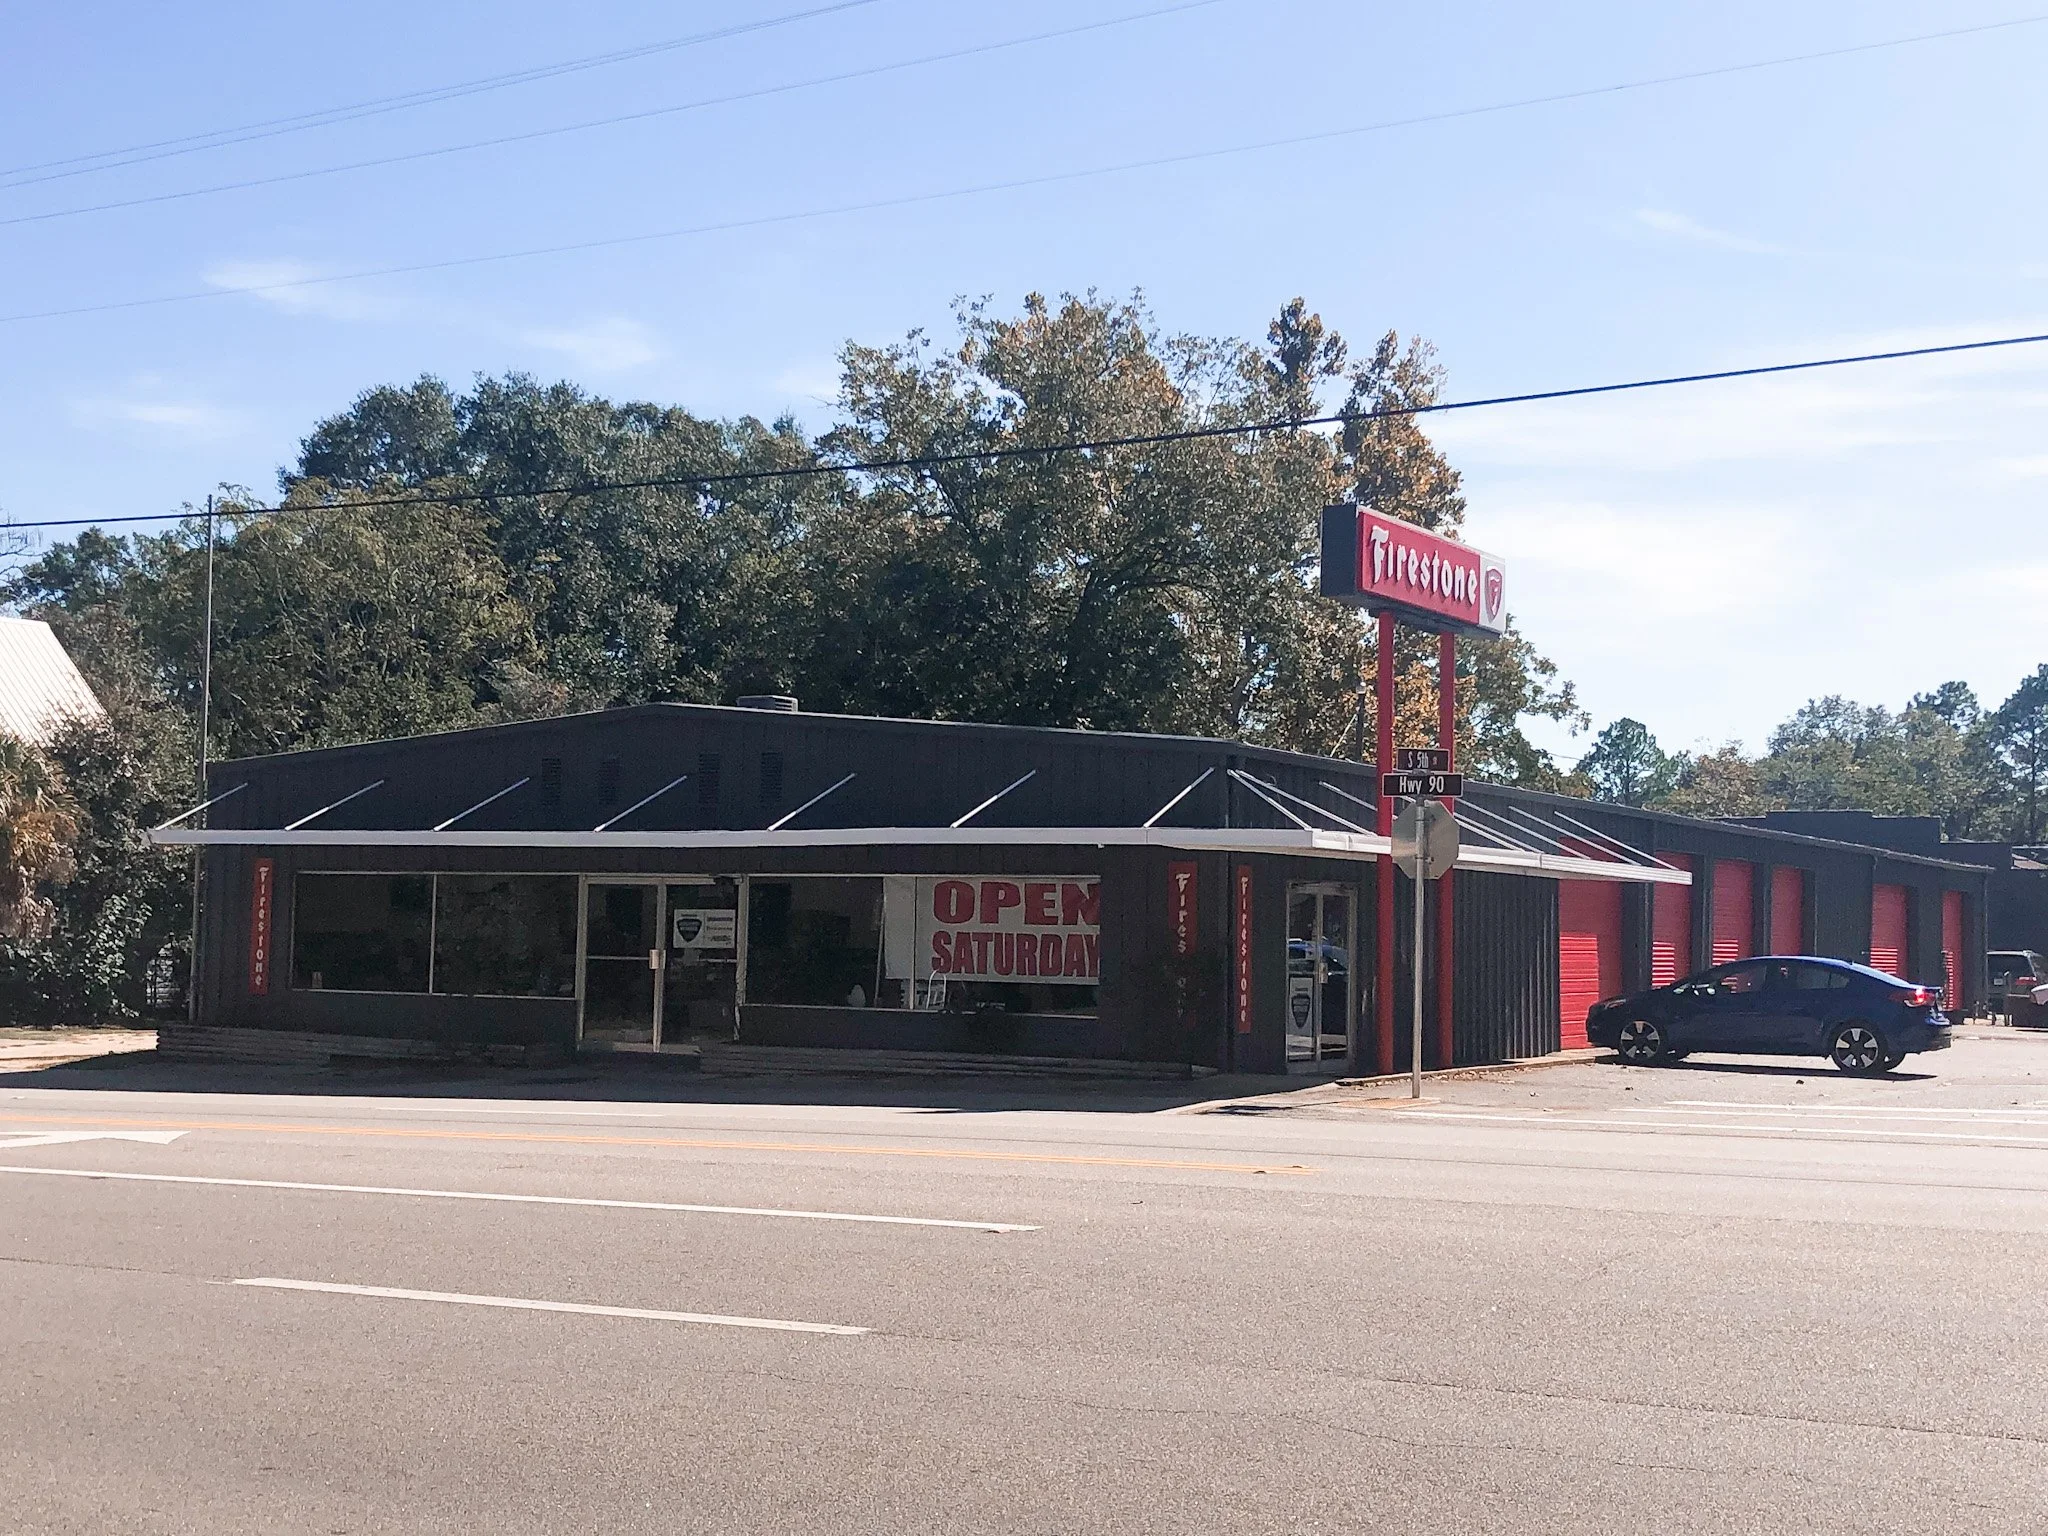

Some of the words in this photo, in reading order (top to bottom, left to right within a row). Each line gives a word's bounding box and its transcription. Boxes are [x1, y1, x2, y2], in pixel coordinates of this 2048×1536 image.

[1370, 524, 1478, 606] Firestone
[1399, 776, 1422, 795] Hwy
[1428, 776, 1445, 793] 90
[1407, 751, 1413, 768] S
[255, 866, 270, 986] Firestone
[933, 880, 1101, 926] OPEN
[1240, 876, 1249, 1023] Firestone
